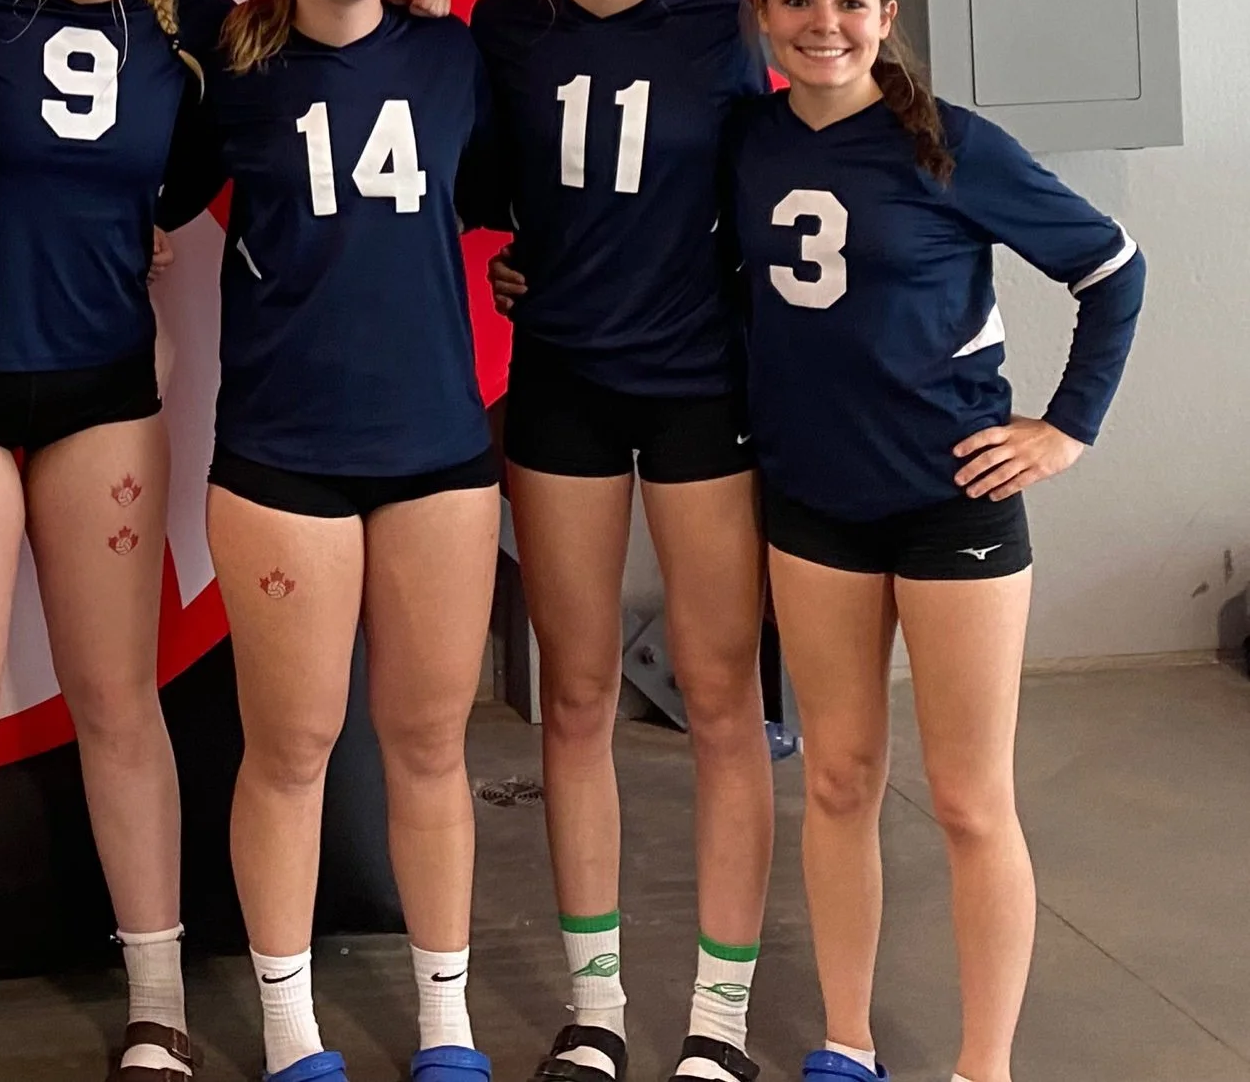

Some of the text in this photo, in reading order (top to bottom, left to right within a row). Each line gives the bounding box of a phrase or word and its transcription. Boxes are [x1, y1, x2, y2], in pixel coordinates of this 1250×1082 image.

[41, 26, 119, 141] 9
[556, 74, 650, 194] 11
[296, 99, 427, 216] 14
[769, 189, 849, 309] 3
